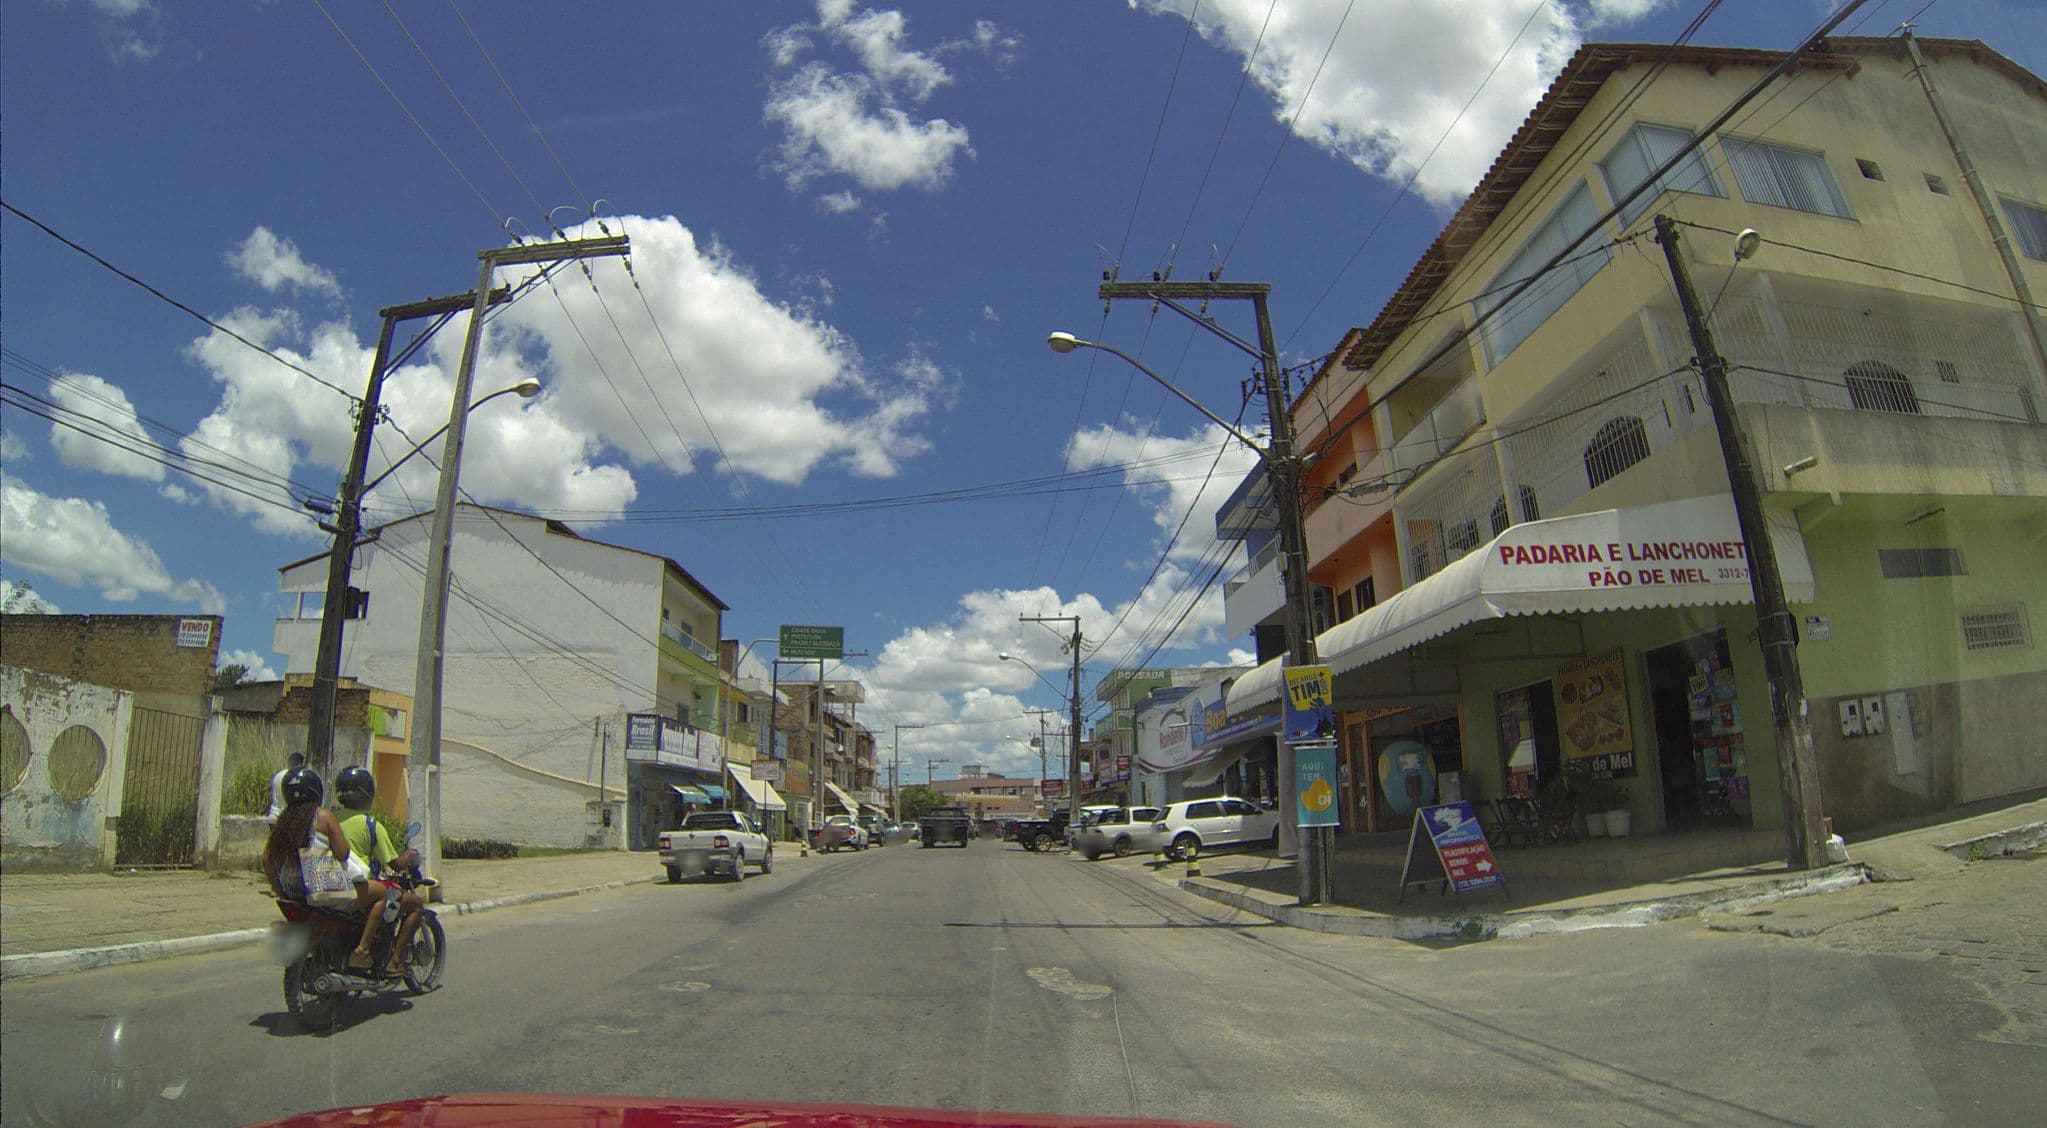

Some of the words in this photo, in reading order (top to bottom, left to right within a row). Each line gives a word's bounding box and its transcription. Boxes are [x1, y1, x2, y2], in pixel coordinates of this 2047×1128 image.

[1500, 543, 1603, 565] PADARIA
[1607, 543, 1623, 562] E
[1588, 567, 1632, 587] PÃO
[1639, 569, 1665, 585] DE
[1670, 568, 1710, 584] MEL
[181, 622, 209, 632] VENDO
[1117, 670, 1165, 680] POUSADA
[1291, 680, 1322, 702] TIM
[631, 725, 656, 736] Brasil
[1610, 752, 1632, 770] Mel
